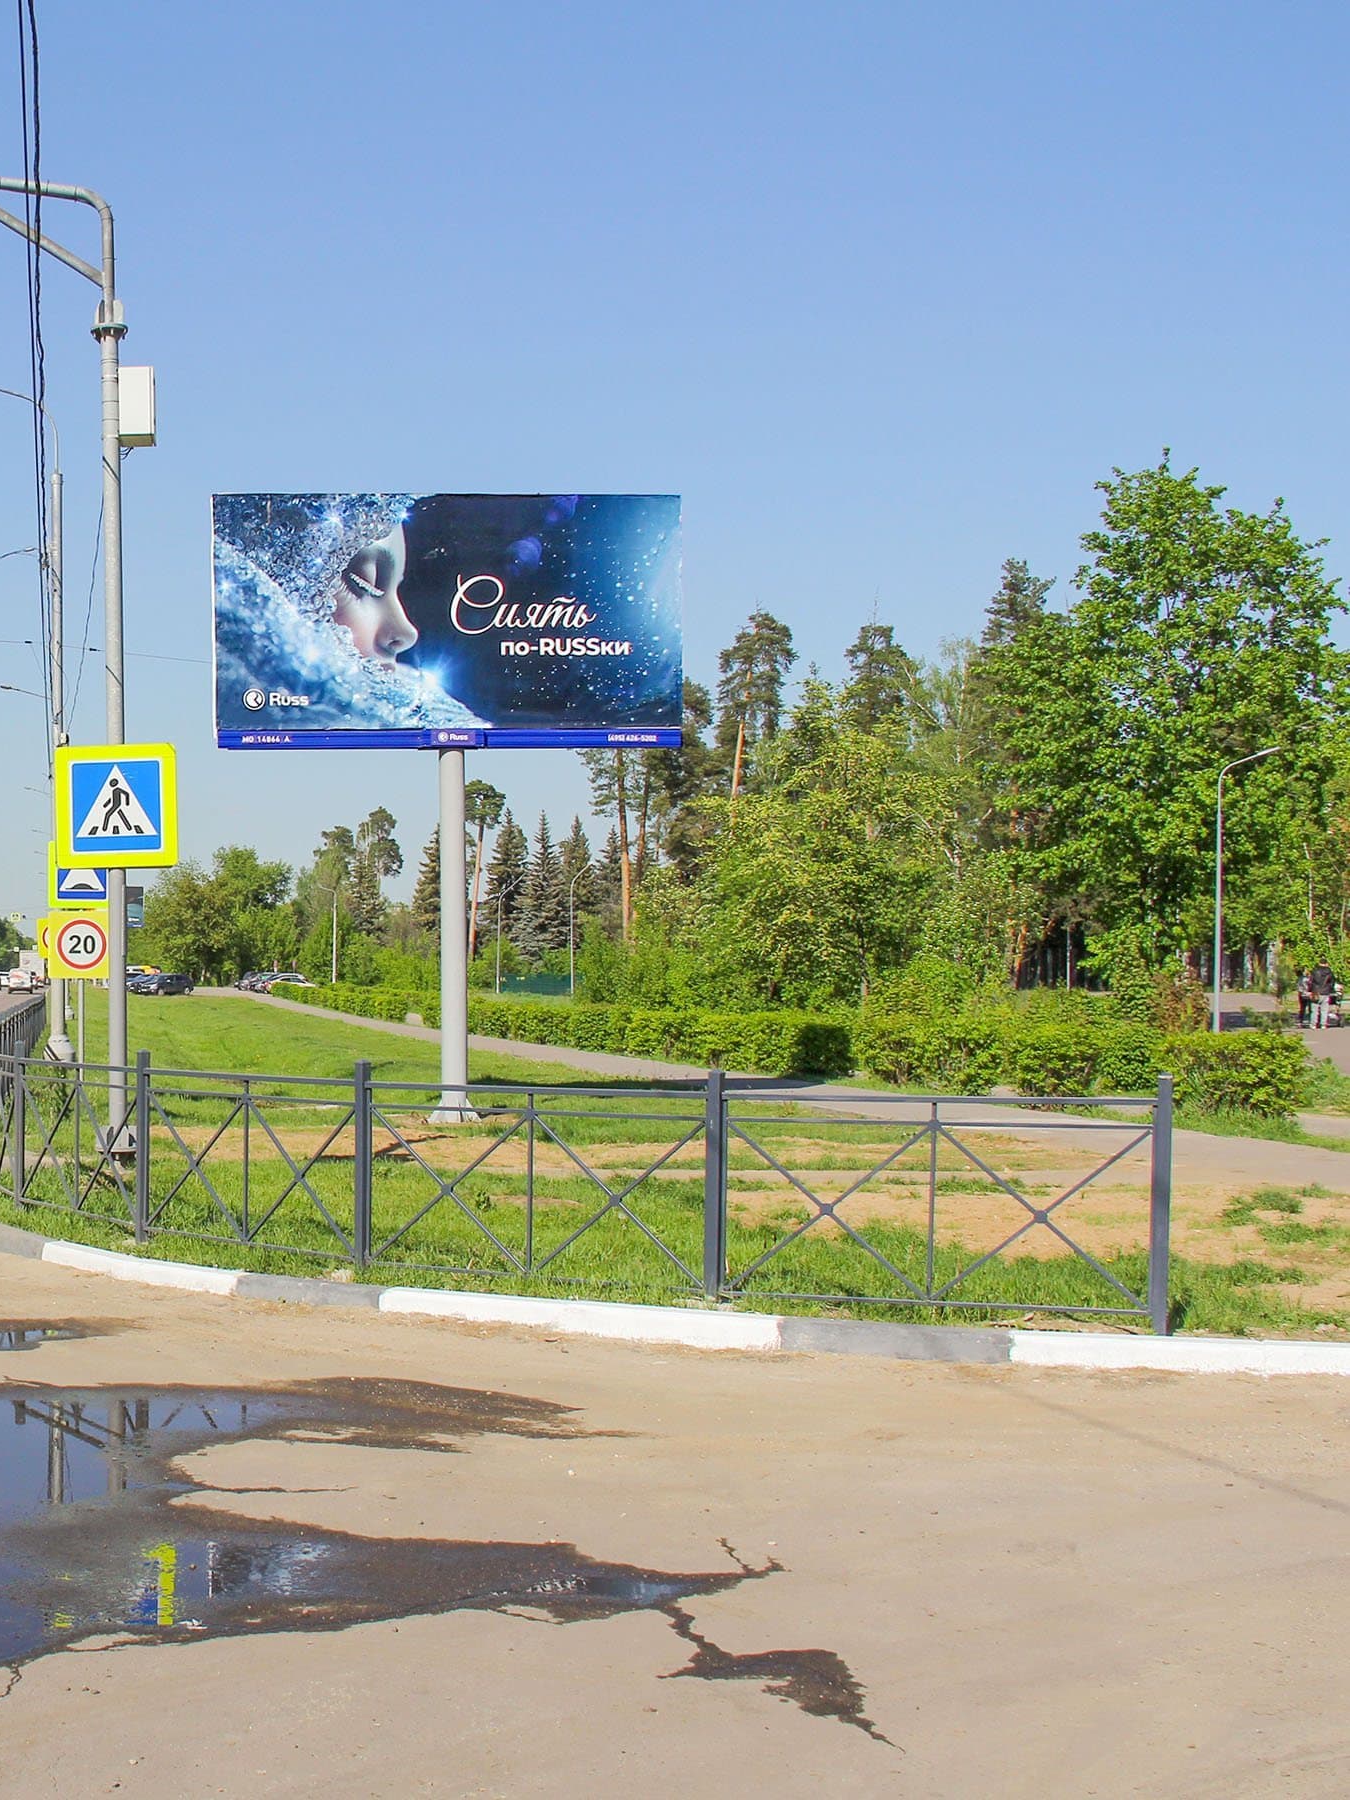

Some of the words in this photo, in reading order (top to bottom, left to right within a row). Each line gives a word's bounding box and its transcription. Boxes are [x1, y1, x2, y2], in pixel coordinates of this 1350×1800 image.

[451, 573, 597, 635] Сиять
[500, 637, 631, 656] по-RUSSки
[269, 692, 309, 707] Russ
[449, 733, 469, 741] Russ
[68, 934, 96, 954] 20
